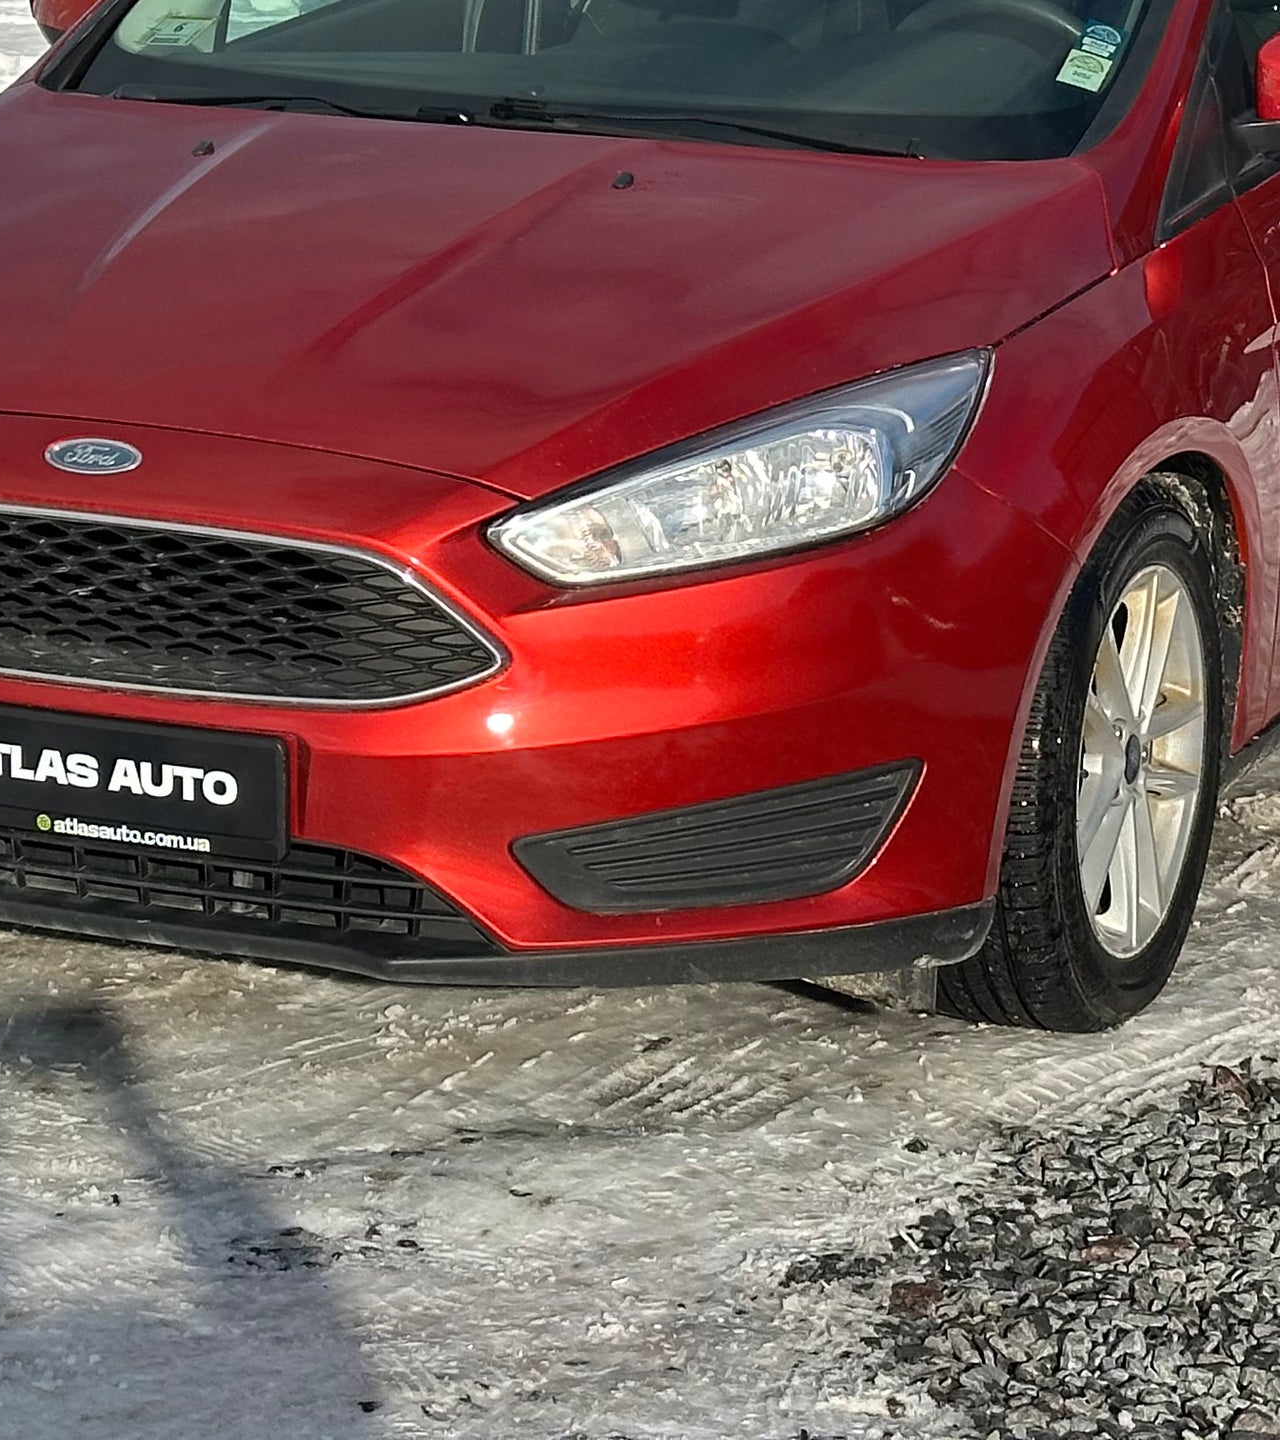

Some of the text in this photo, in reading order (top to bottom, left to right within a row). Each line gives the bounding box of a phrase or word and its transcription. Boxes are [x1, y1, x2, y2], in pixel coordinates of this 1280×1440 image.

[64, 444, 120, 465] Ford
[108, 758, 238, 805] AUTO
[53, 817, 211, 853] atlasauto.com.ua
